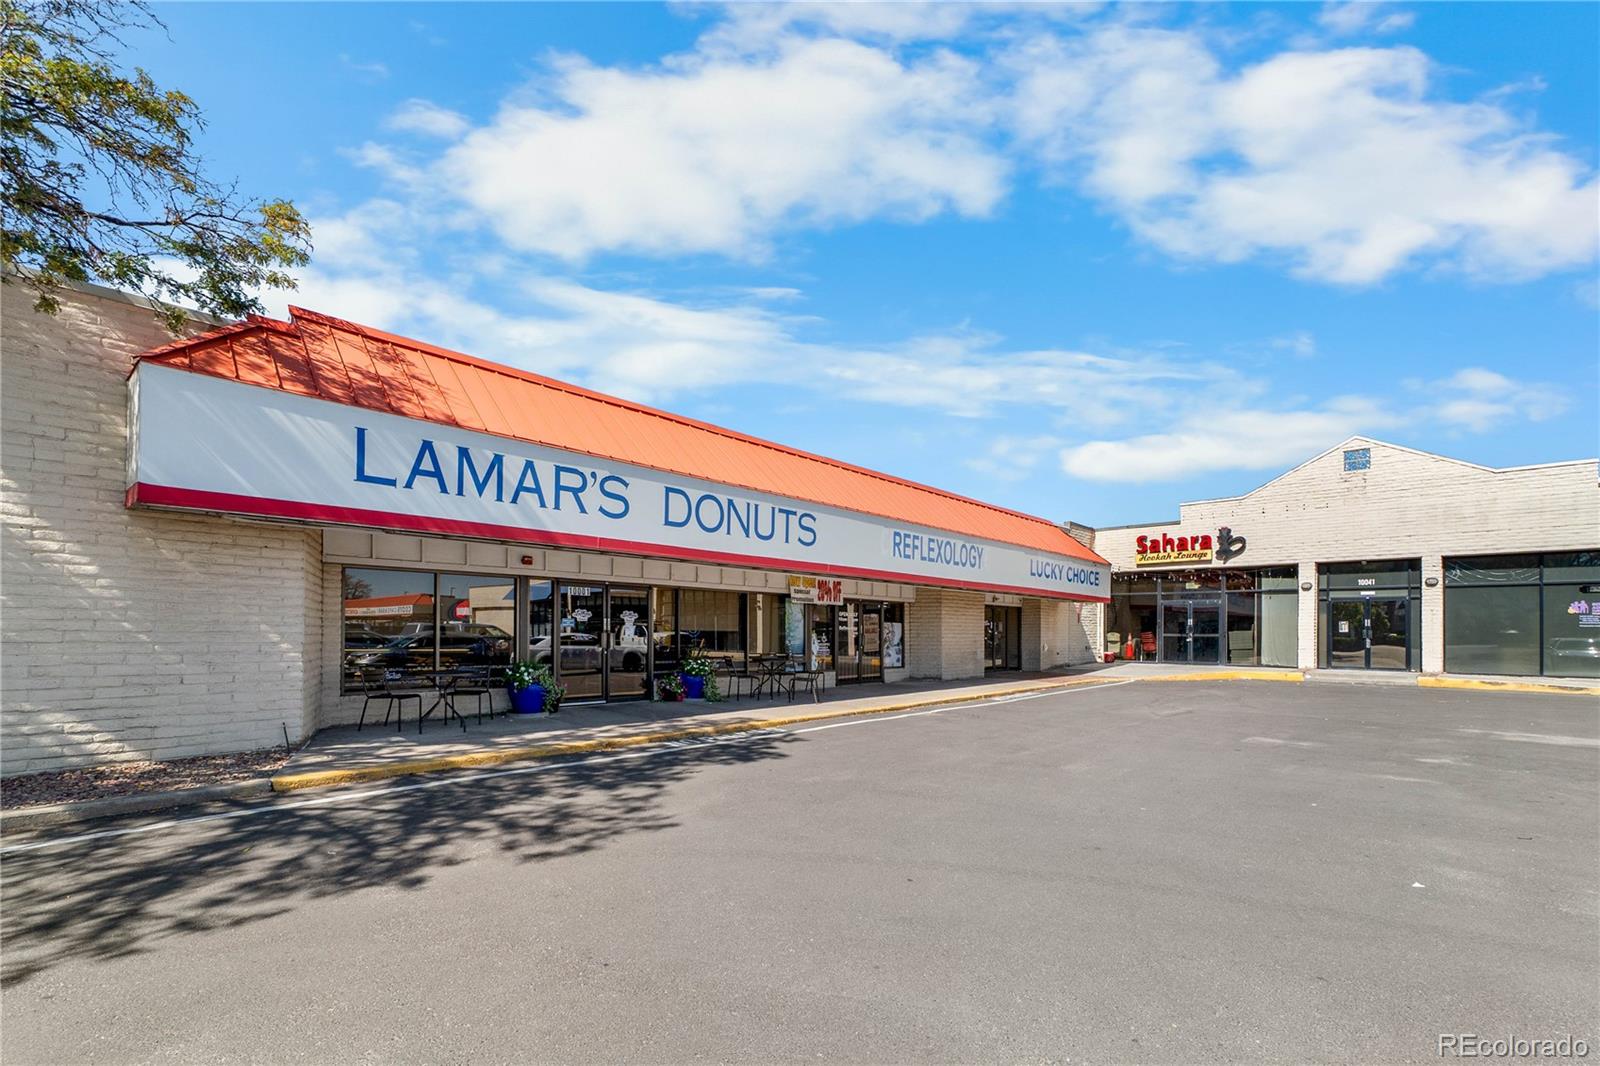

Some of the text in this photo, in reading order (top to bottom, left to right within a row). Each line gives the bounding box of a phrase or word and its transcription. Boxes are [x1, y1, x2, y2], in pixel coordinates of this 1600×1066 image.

[354, 426, 817, 547] LAMAR'S DONUTS
[893, 530, 984, 569] REFLEXOLOGY
[1136, 532, 1212, 555] Sahara
[1139, 551, 1208, 562] Hookah Lounge
[1030, 558, 1100, 587] LUCKY CHOICE
[1357, 578, 1376, 586] 10041
[568, 586, 591, 597] 10001
